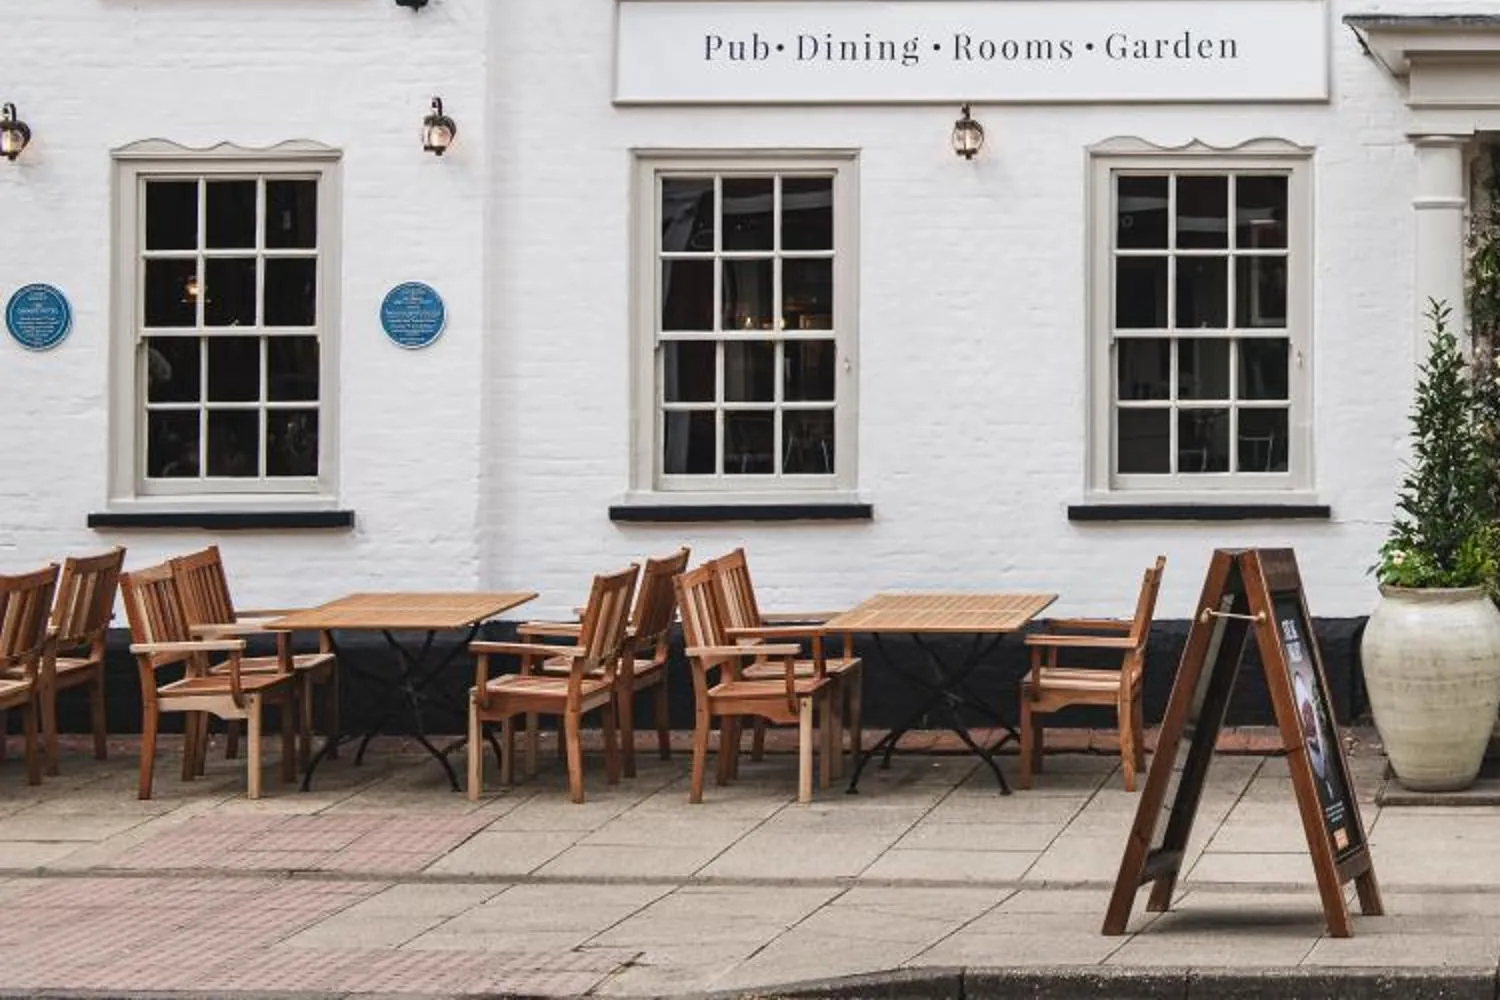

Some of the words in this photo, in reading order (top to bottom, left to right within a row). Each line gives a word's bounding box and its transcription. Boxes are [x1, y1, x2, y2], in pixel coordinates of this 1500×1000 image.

[704, 32, 770, 61] Pub
[797, 32, 919, 67] Dining
[953, 33, 1073, 61] Rooms
[1105, 31, 1238, 60] Garden
